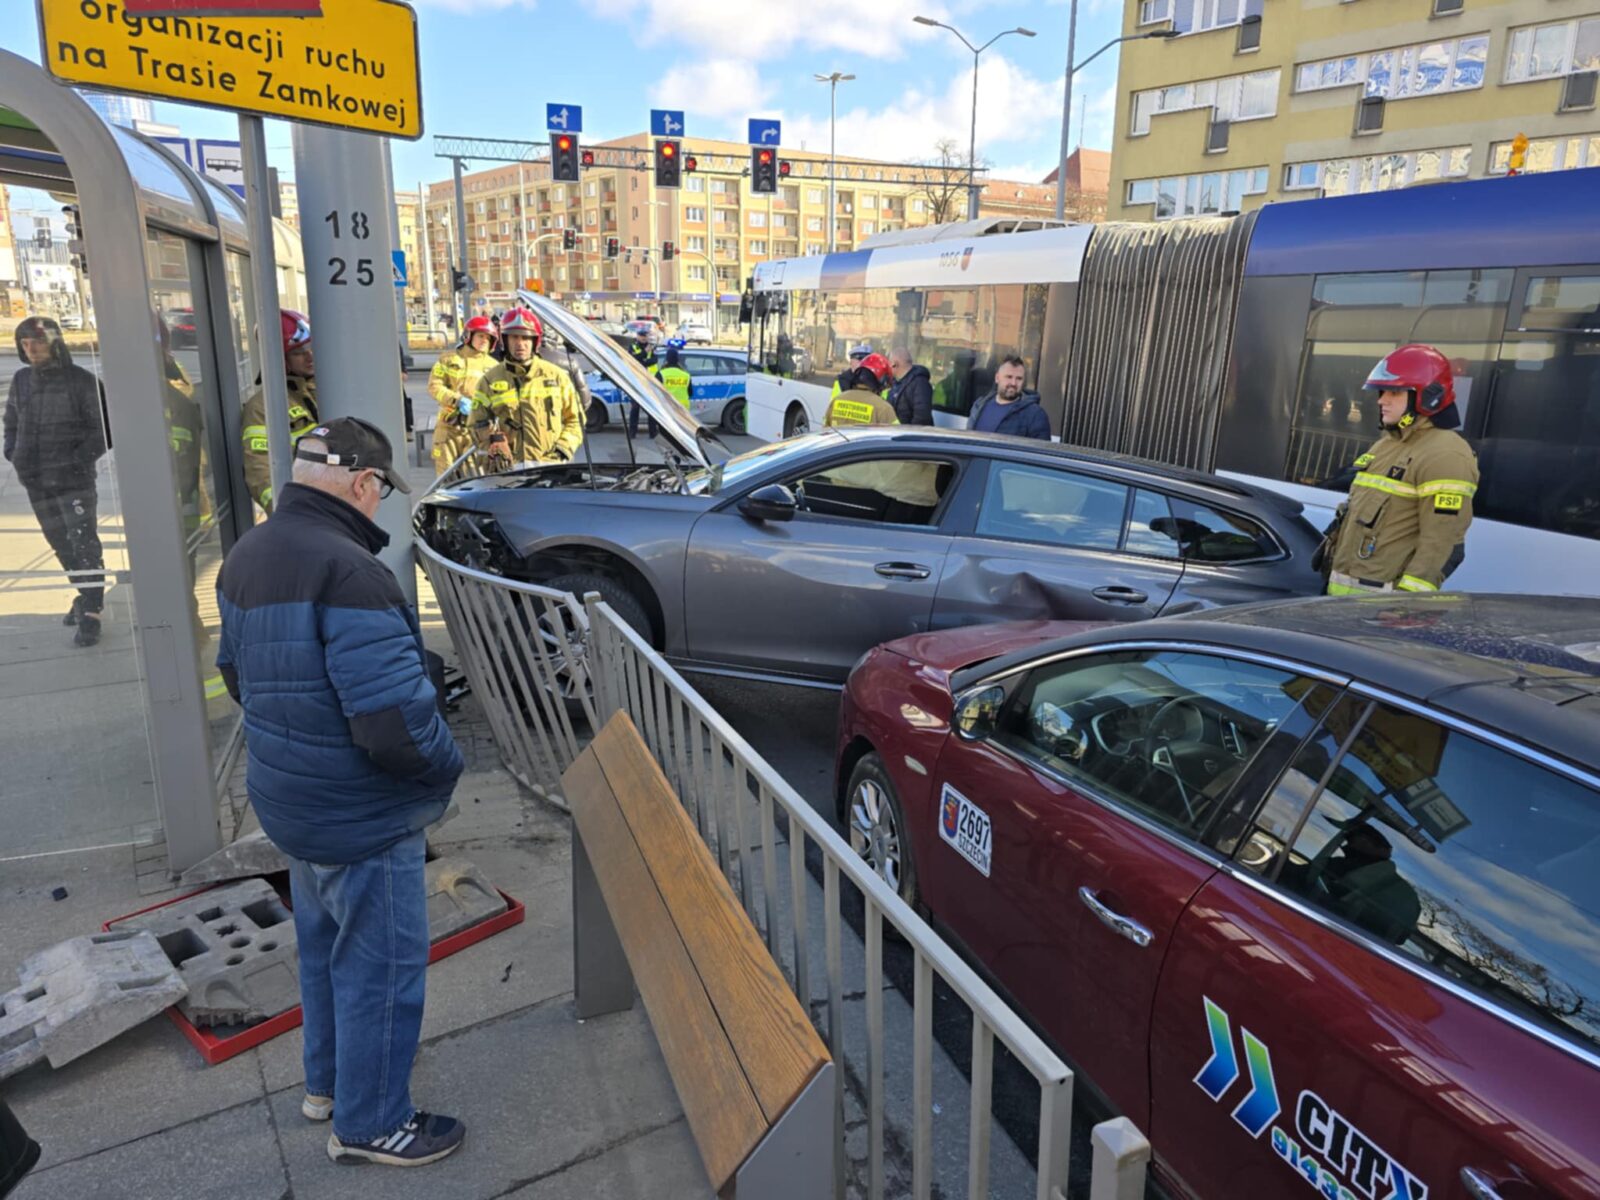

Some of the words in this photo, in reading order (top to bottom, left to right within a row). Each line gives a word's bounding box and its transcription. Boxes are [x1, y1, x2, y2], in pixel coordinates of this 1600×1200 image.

[80, 0, 283, 63] organizacji
[305, 46, 385, 79] ruchu
[58, 41, 107, 69] na
[128, 45, 237, 92] Trasie
[257, 70, 405, 129] Zamkowej
[325, 210, 369, 240] 18
[328, 257, 375, 287] 25
[1438, 496, 1460, 505] PSP
[960, 804, 990, 850] 2697
